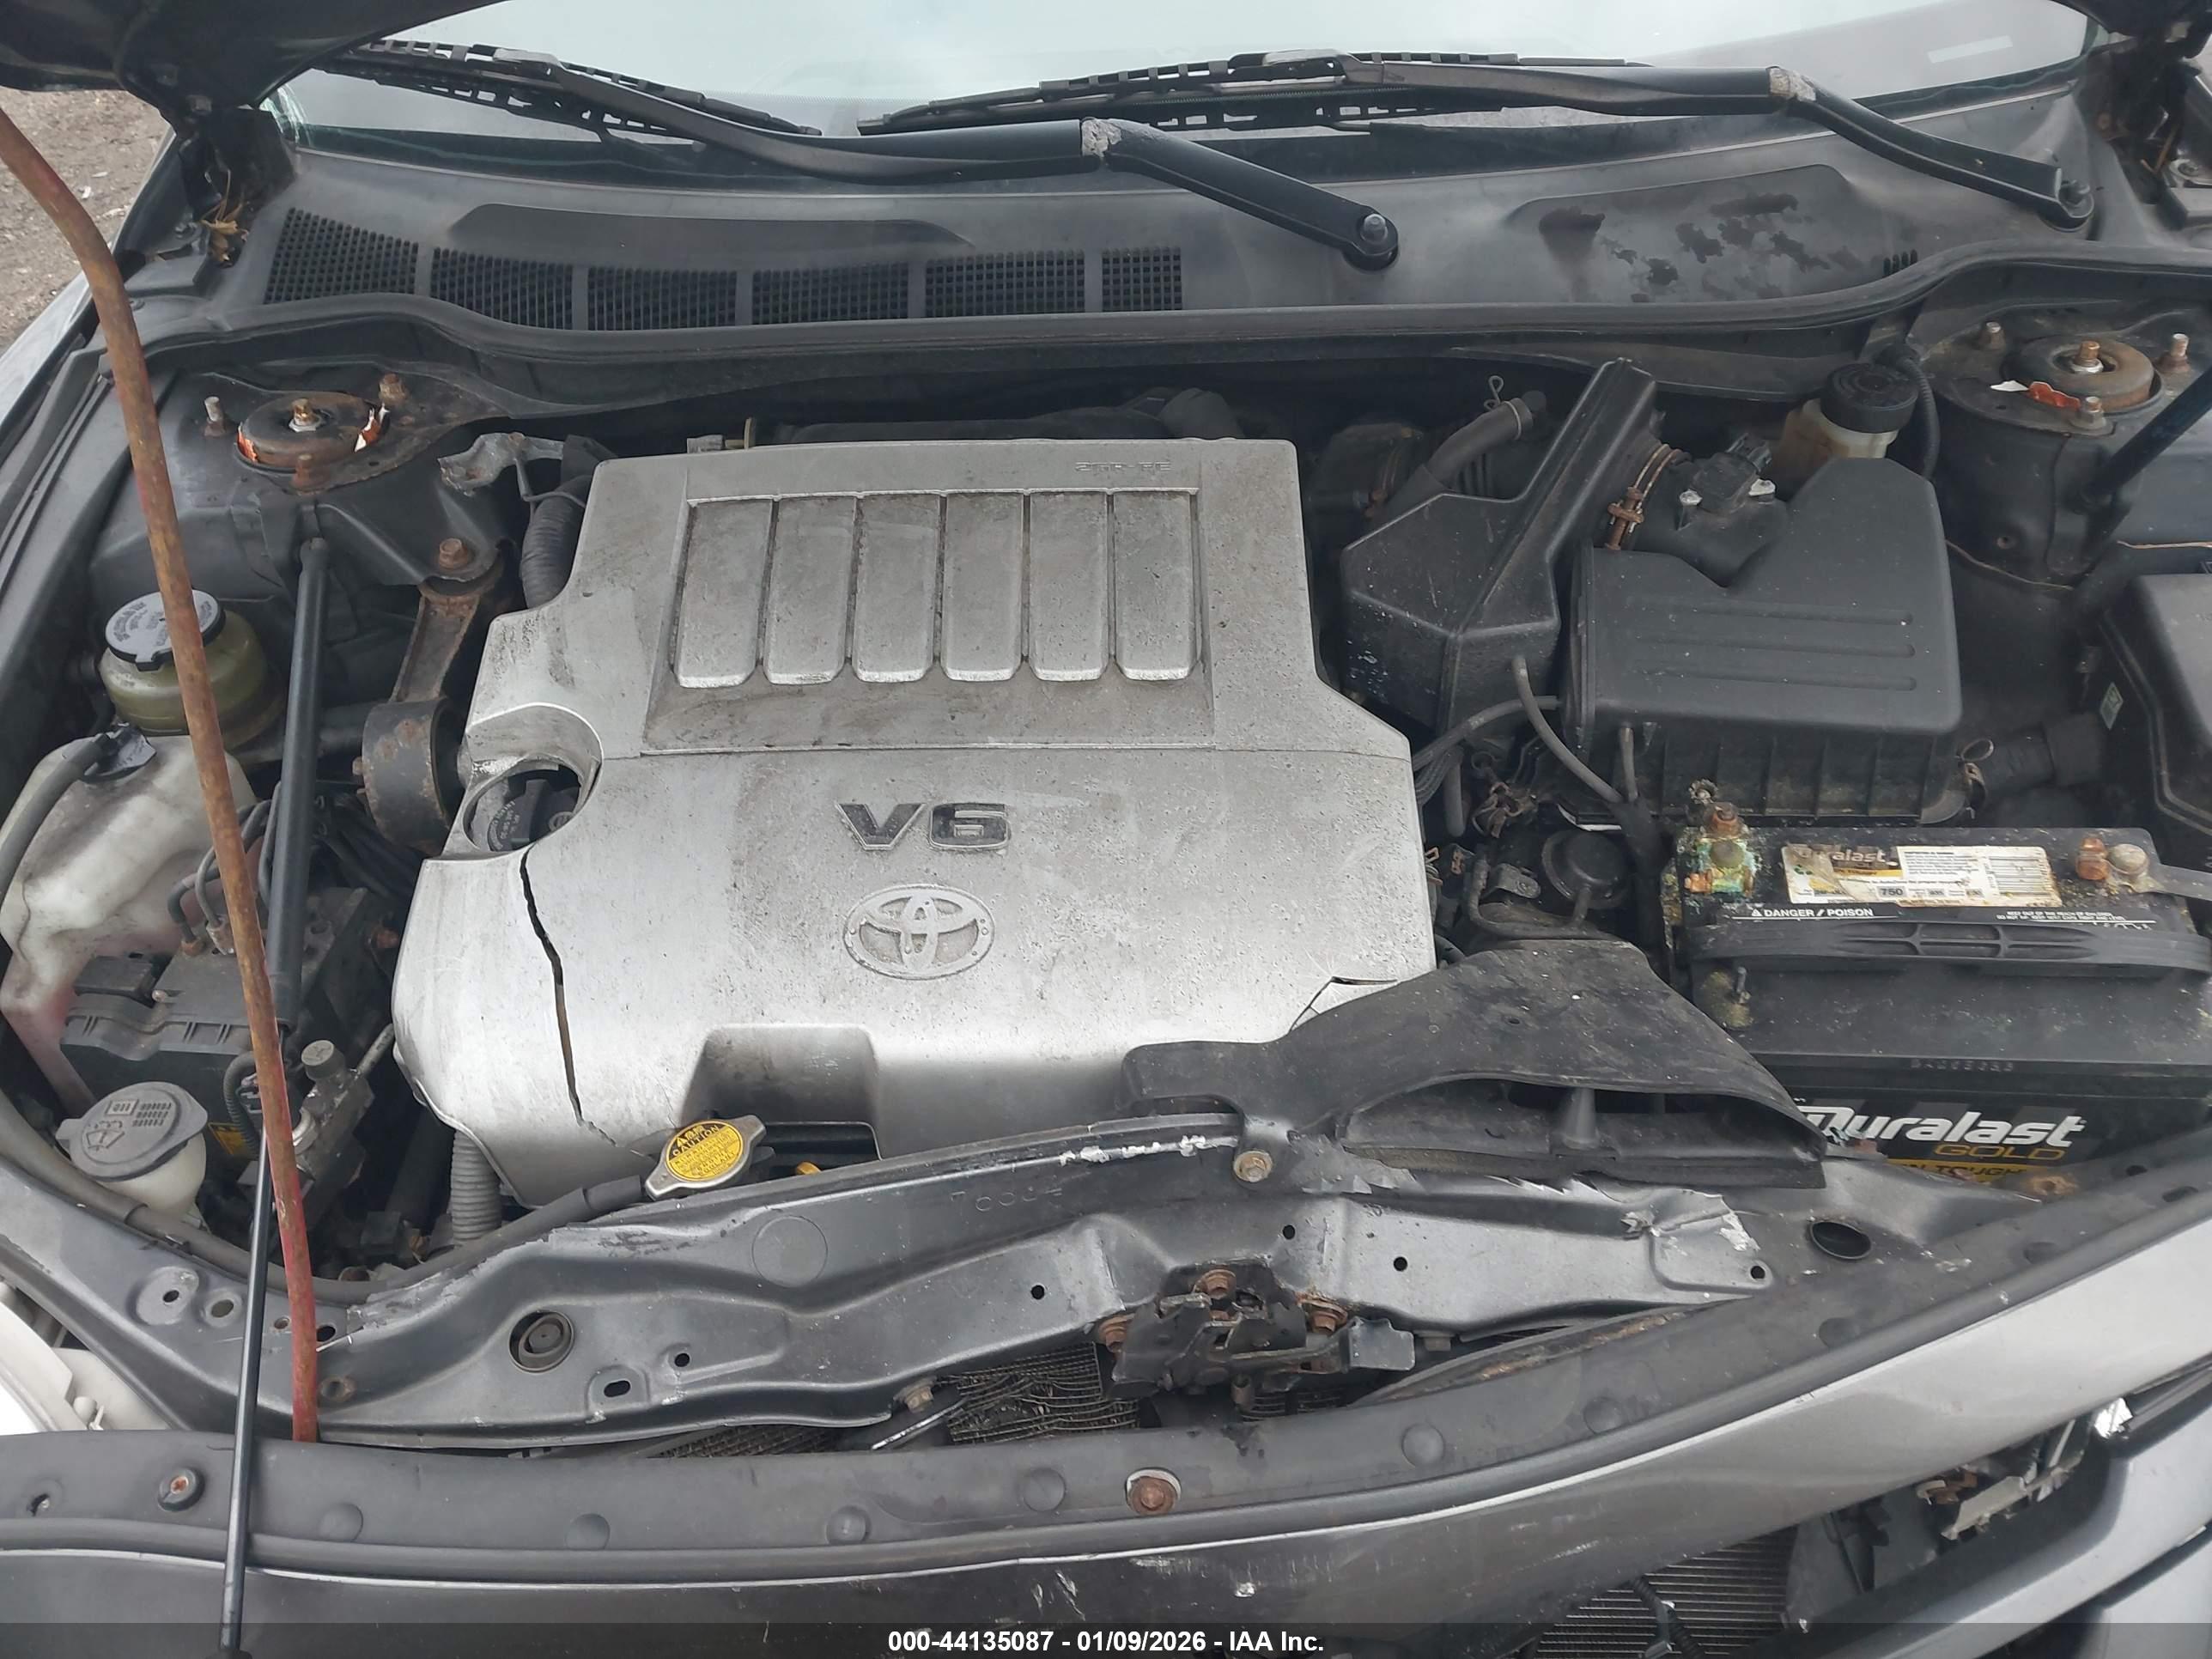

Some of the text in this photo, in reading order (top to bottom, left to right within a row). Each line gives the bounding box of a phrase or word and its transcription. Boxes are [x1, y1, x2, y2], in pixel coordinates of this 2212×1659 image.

[835, 801, 1012, 852] V6
[1880, 887, 1904, 896] 750
[1763, 908, 1815, 917] DANGER
[1826, 908, 1875, 917] POISON
[1796, 1104, 2086, 1148] Duralast
[672, 1124, 720, 1157] CAUTION
[1934, 1144, 2066, 1161] GOLD
